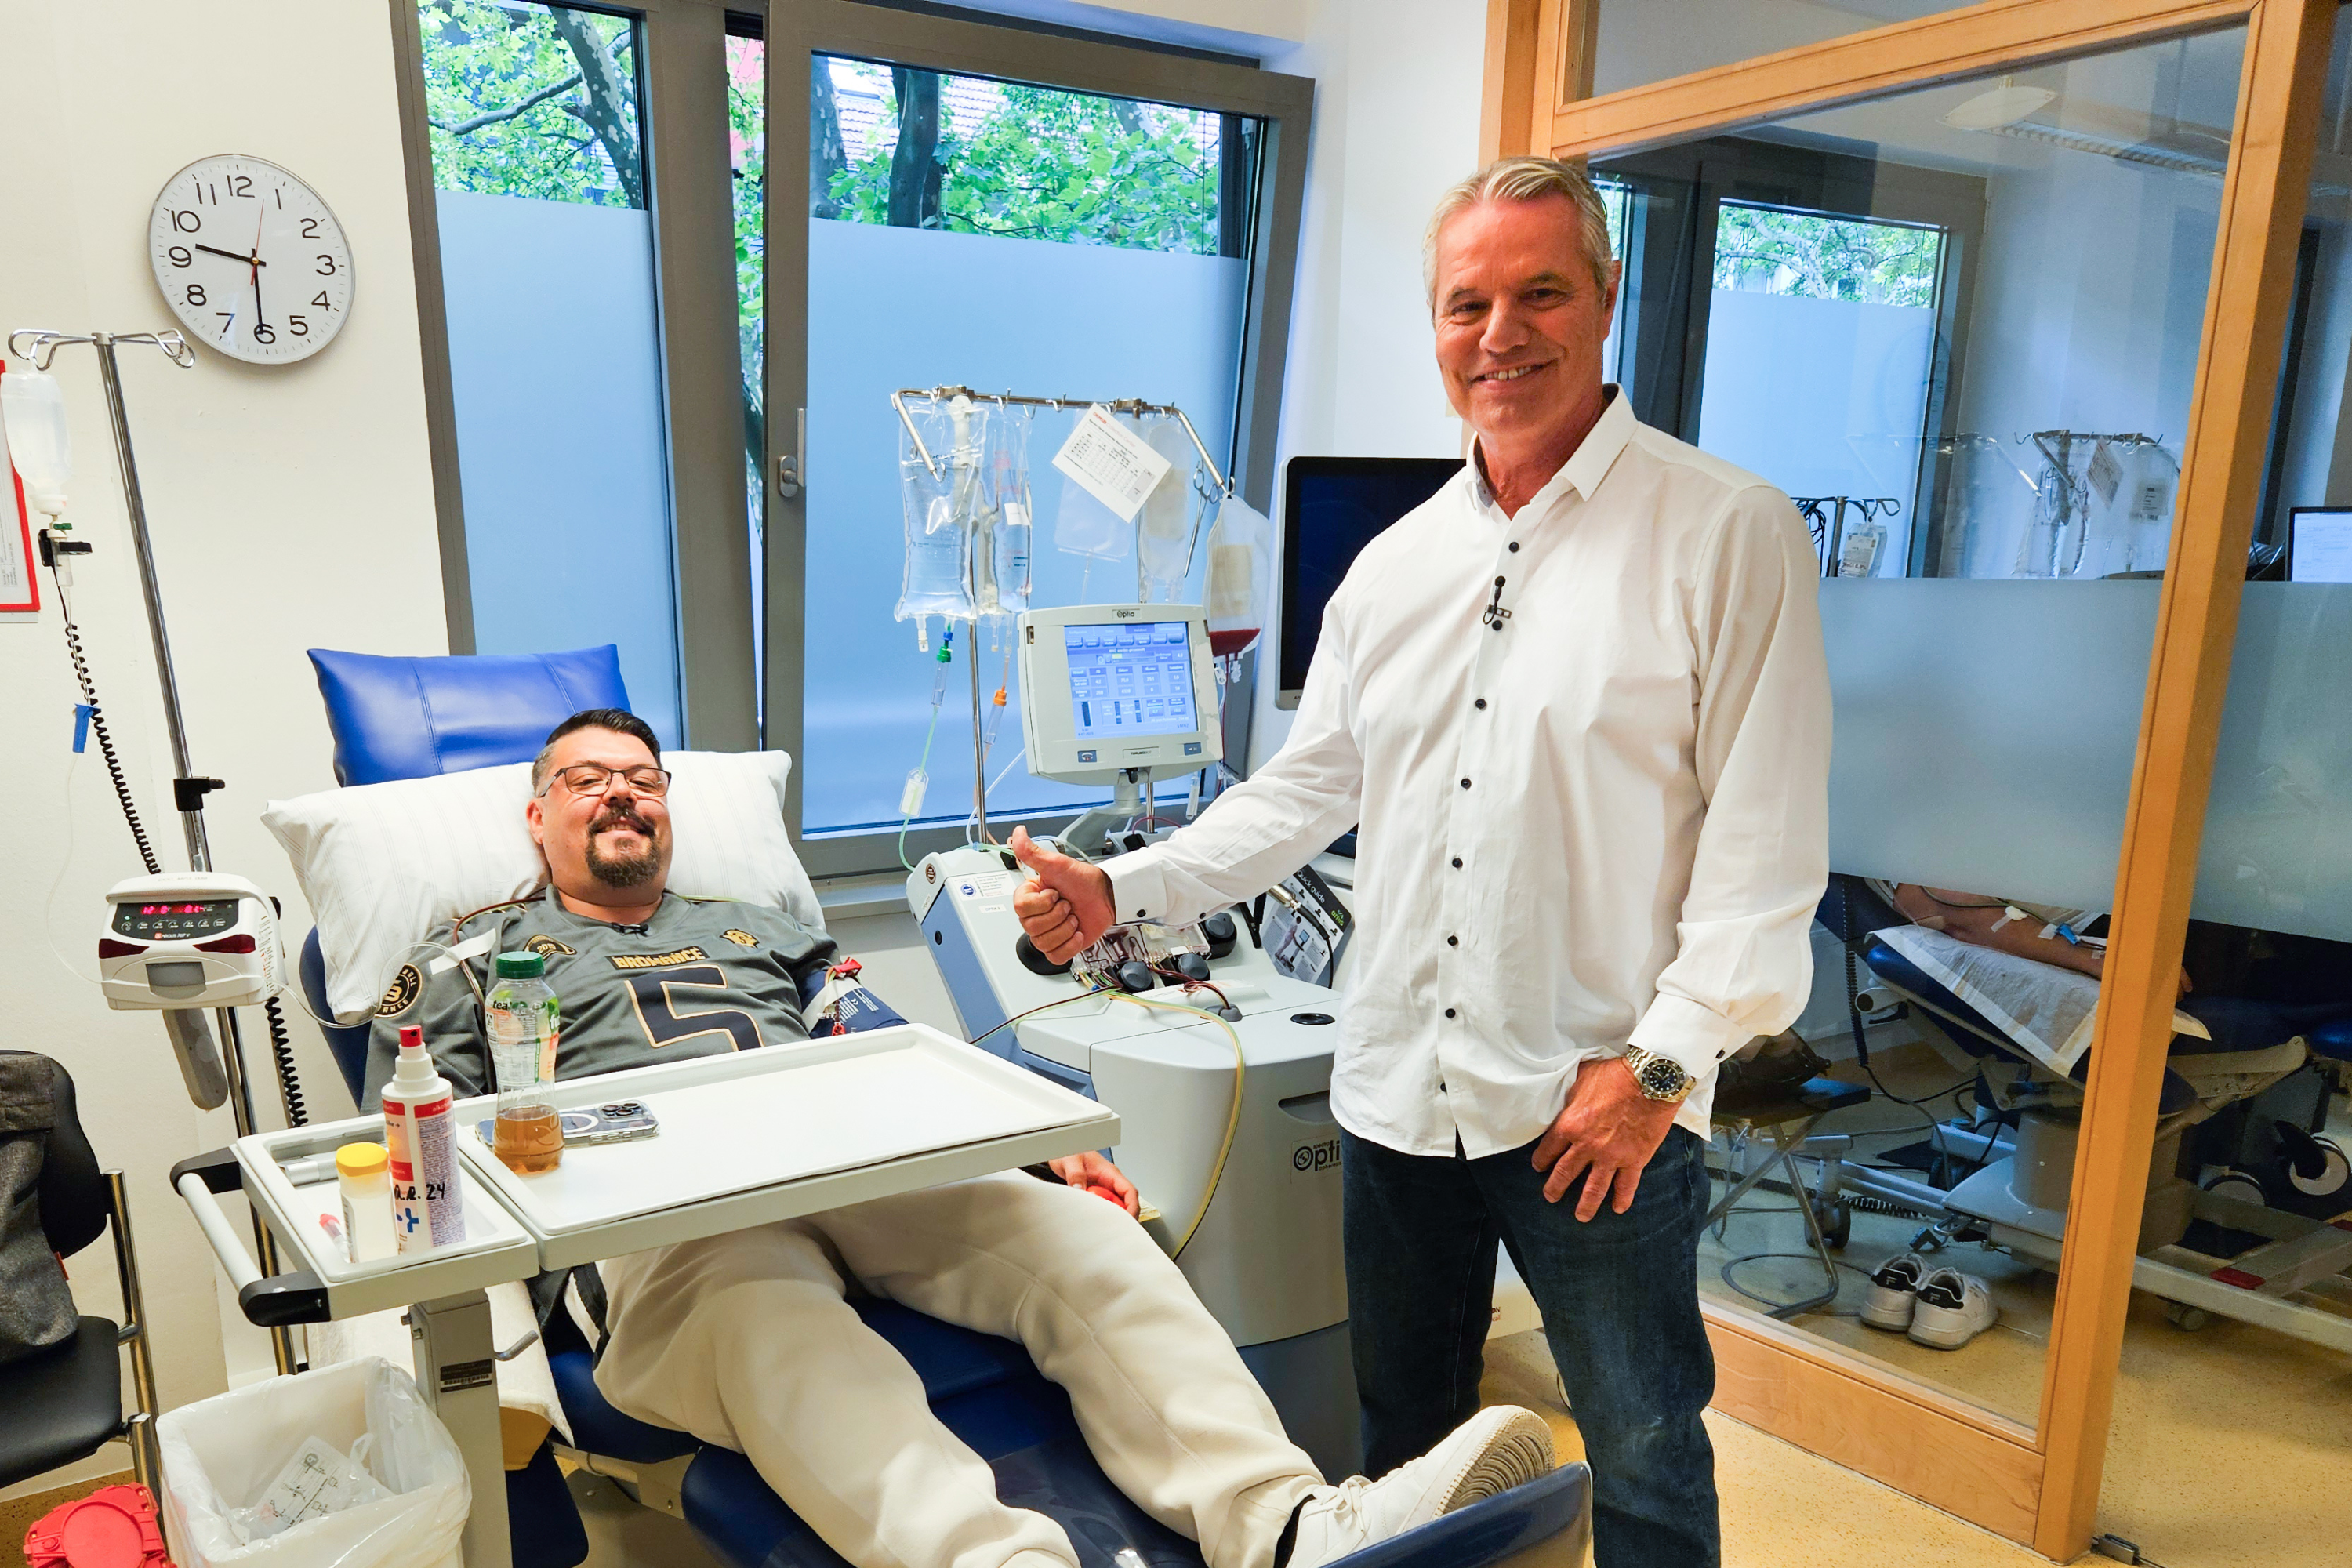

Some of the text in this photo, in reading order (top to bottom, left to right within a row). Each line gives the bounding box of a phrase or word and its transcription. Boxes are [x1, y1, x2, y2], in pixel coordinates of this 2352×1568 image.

[196, 182, 217, 205] 11
[226, 174, 256, 198] 12
[274, 188, 282, 210] 1
[171, 210, 201, 234] 10
[300, 218, 321, 239] 2
[168, 245, 192, 268] 9
[315, 254, 336, 275] 3
[187, 284, 207, 307] 8
[310, 290, 331, 312] 4
[216, 312, 236, 333] 7
[289, 314, 309, 336] 5
[253, 323, 276, 345] 6
[1297, 870, 1325, 904] Quick guide
[536, 943, 557, 953] 2019
[612, 947, 706, 968] BROMANCE
[492, 1000, 508, 1010] tea
[624, 964, 765, 1052] 5
[550, 1014, 560, 1029] fu
[1293, 1140, 1340, 1171] Opti
[426, 1181, 445, 1200] 24
